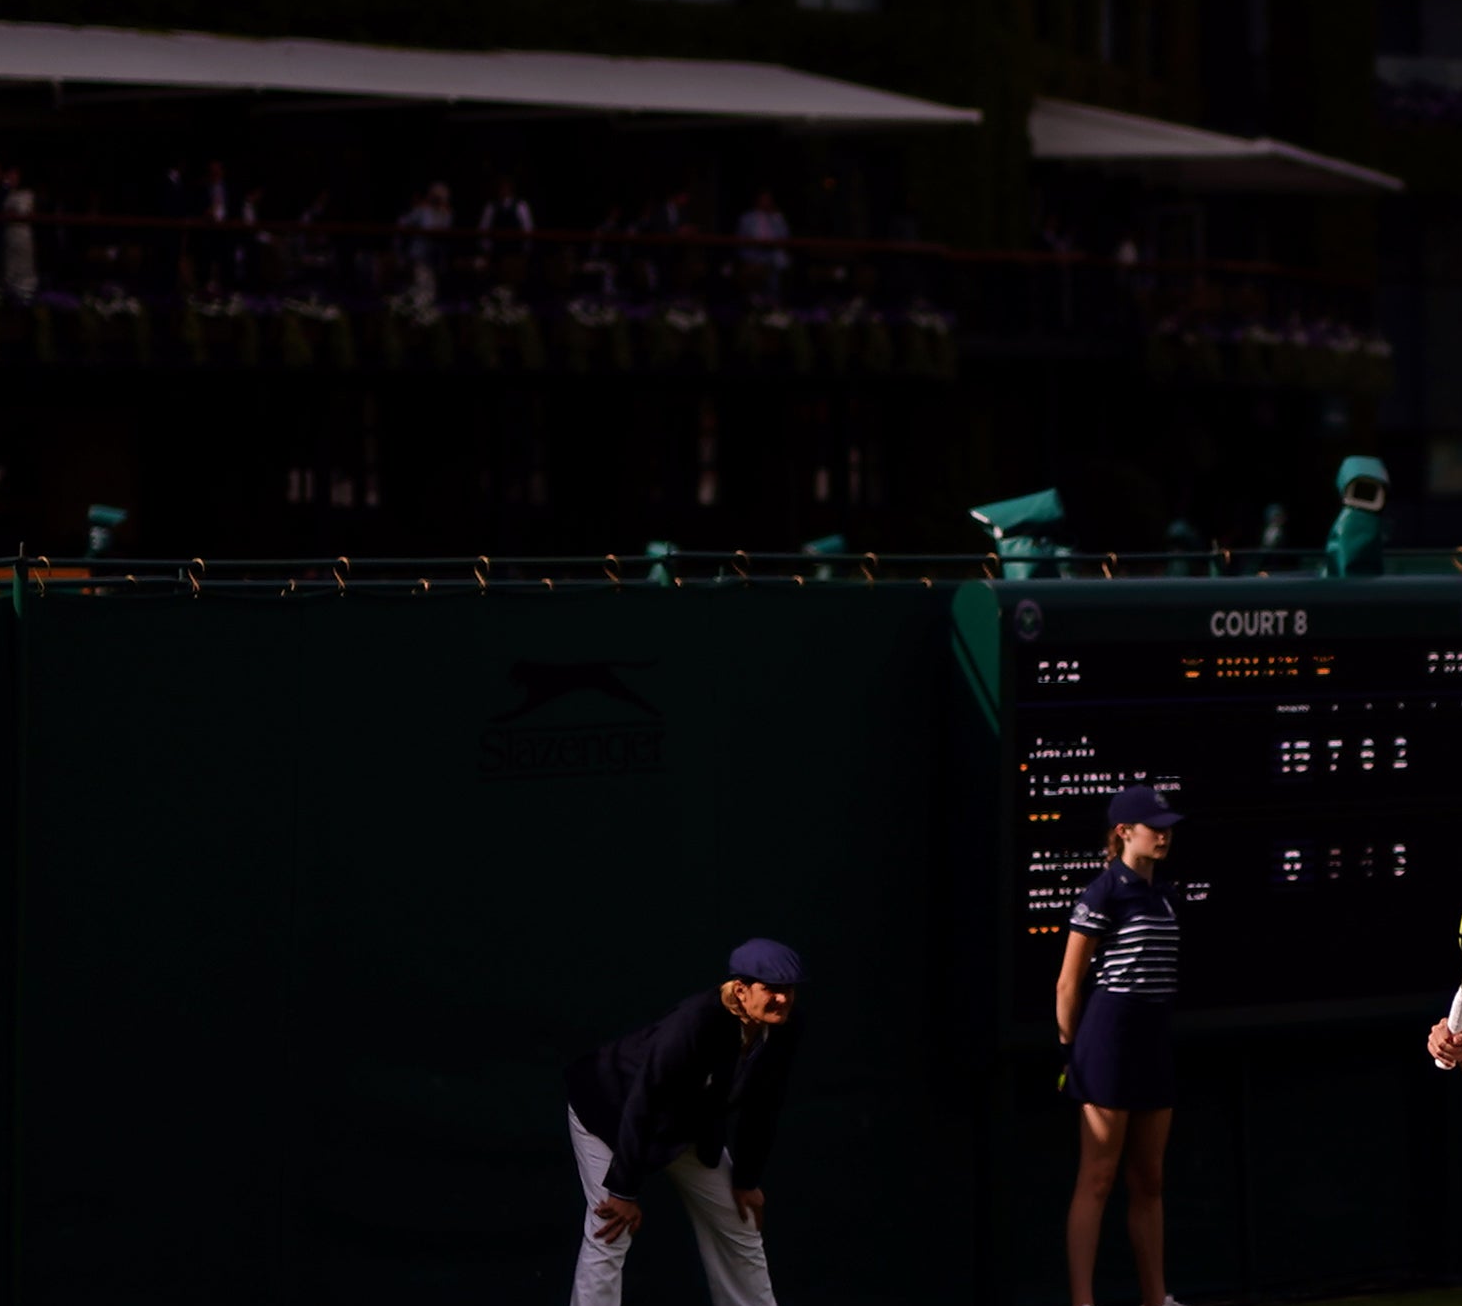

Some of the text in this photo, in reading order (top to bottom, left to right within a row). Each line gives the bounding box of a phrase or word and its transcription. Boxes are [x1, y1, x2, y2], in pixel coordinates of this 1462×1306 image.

[1210, 609, 1308, 636] COURT 8
[476, 727, 666, 776] Slazenger
